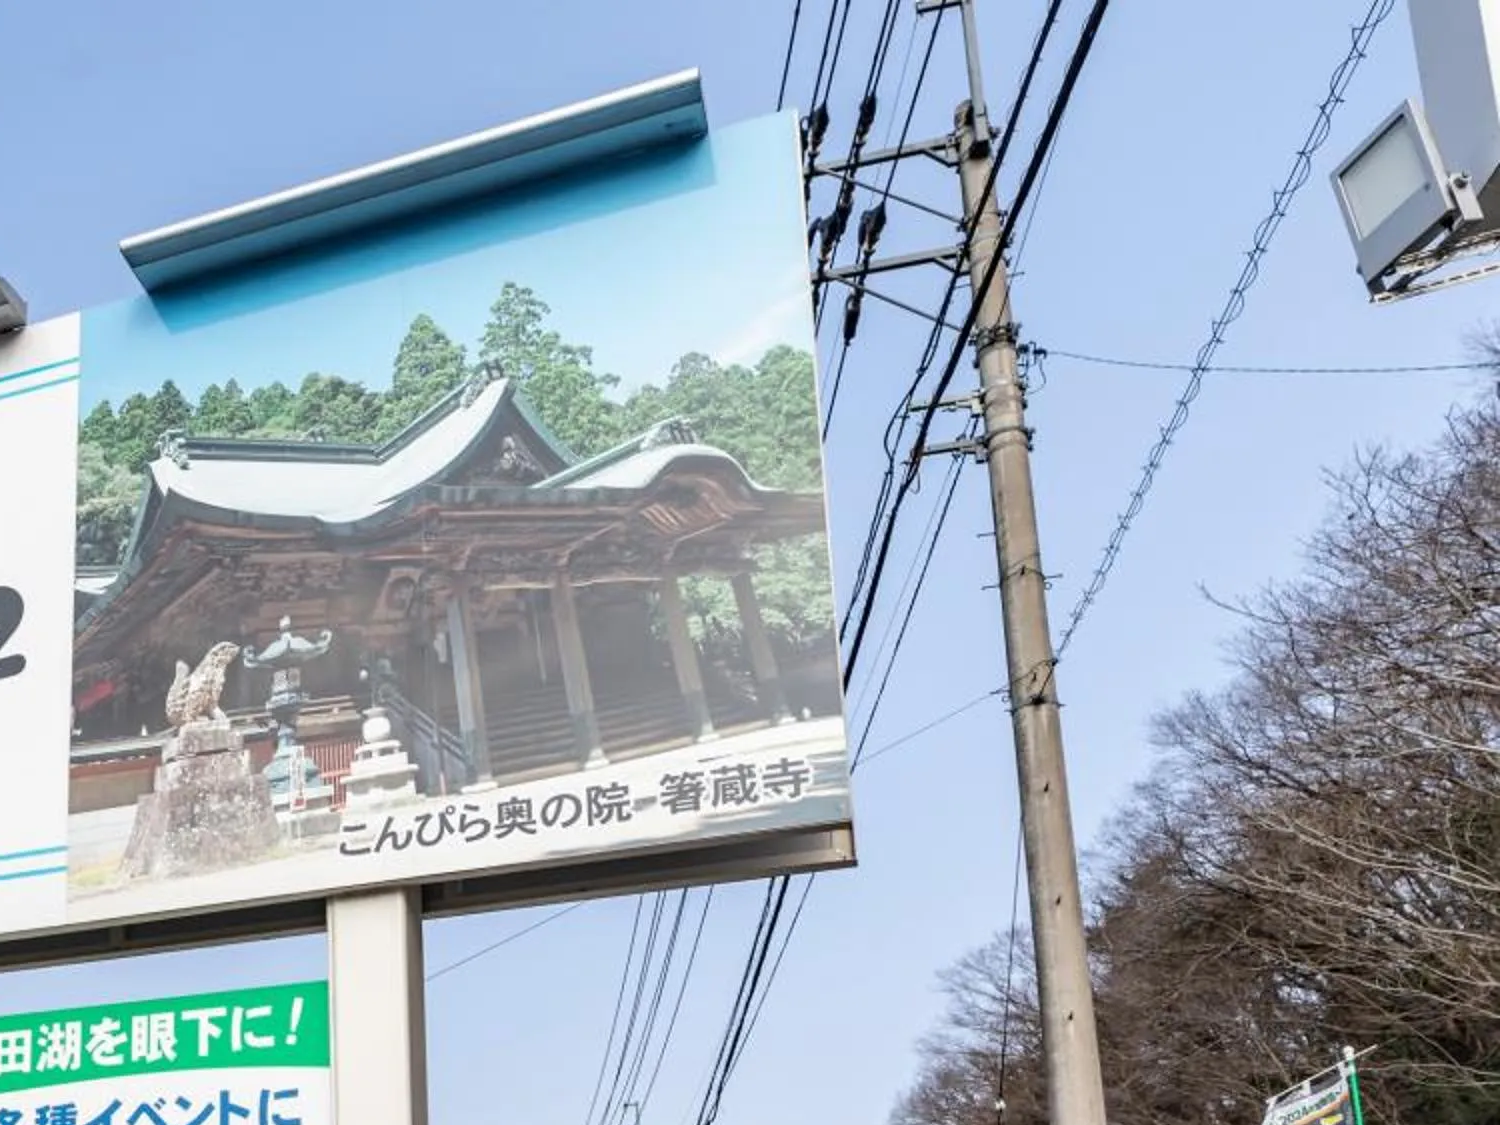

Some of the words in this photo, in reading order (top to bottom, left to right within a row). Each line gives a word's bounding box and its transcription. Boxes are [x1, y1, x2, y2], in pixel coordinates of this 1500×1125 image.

[338, 781, 633, 858] こんぴら奥の院
[659, 757, 816, 816] 箸蔵寺
